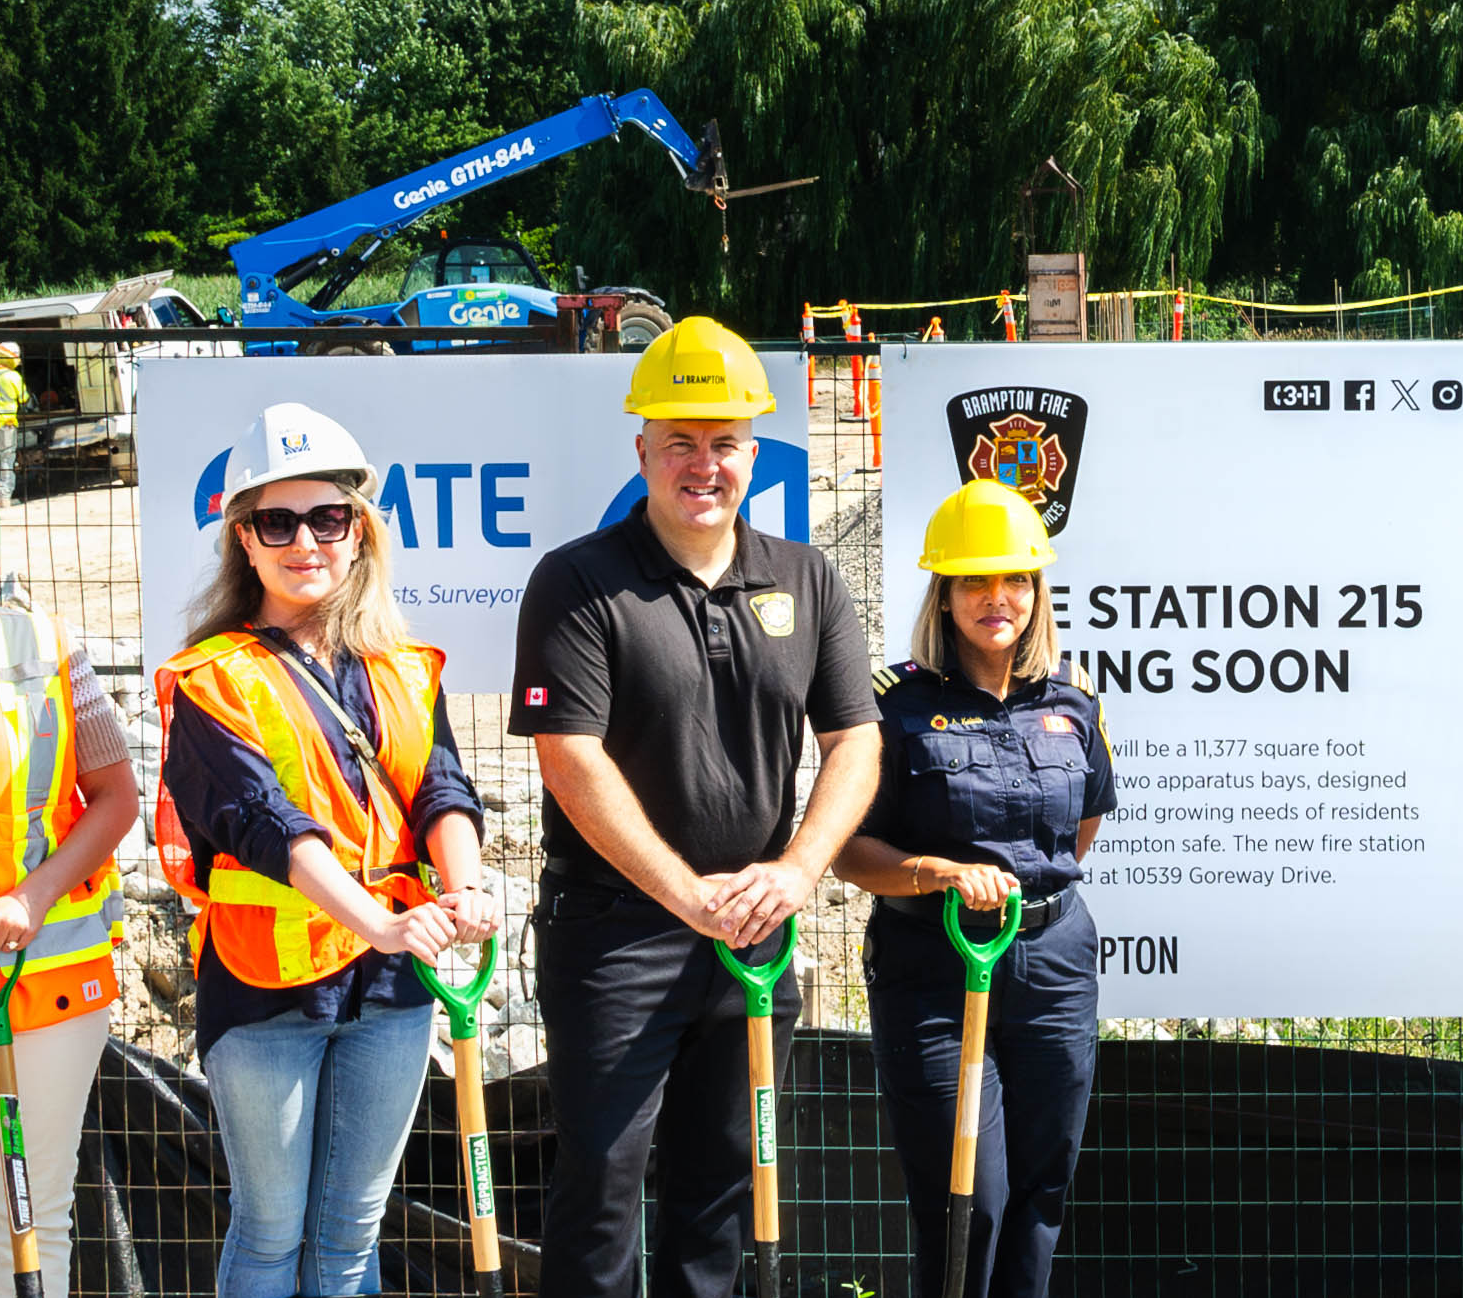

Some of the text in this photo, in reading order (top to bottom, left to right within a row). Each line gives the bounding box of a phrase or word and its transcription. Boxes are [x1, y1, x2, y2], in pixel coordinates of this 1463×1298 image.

[394, 137, 535, 209] Genie GTH-844
[449, 300, 521, 325] Genie
[686, 375, 726, 384] BRAMPTON
[962, 390, 1072, 419] BRAMPTON FIRE
[1041, 501, 1067, 528] VICES
[1088, 585, 1319, 629] STATION
[1338, 585, 1423, 629] 215
[1191, 649, 1349, 694] SOON
[1146, 739, 1170, 757] be
[1176, 743, 1187, 757] a
[1194, 739, 1247, 759] 11,377
[1254, 742, 1320, 759] square
[1326, 739, 1366, 757] foot
[1115, 770, 1407, 792] two apparatus bays, designed
[1154, 803, 1234, 824] growing
[1241, 803, 1299, 821] needs
[1305, 803, 1325, 820] of
[1331, 803, 1420, 820] residents
[1088, 834, 1426, 855] rampton safe. The new fire station
[1100, 869, 1118, 884] at
[1125, 867, 1182, 885] 10539
[1189, 866, 1274, 887] Goreway
[1282, 866, 1337, 884] Drive.
[760, 1091, 774, 1149] PRACTICA
[11, 1158, 28, 1199] TEMPER
[473, 1138, 491, 1198] PRACTICA
[18, 1197, 31, 1226] TRUE
